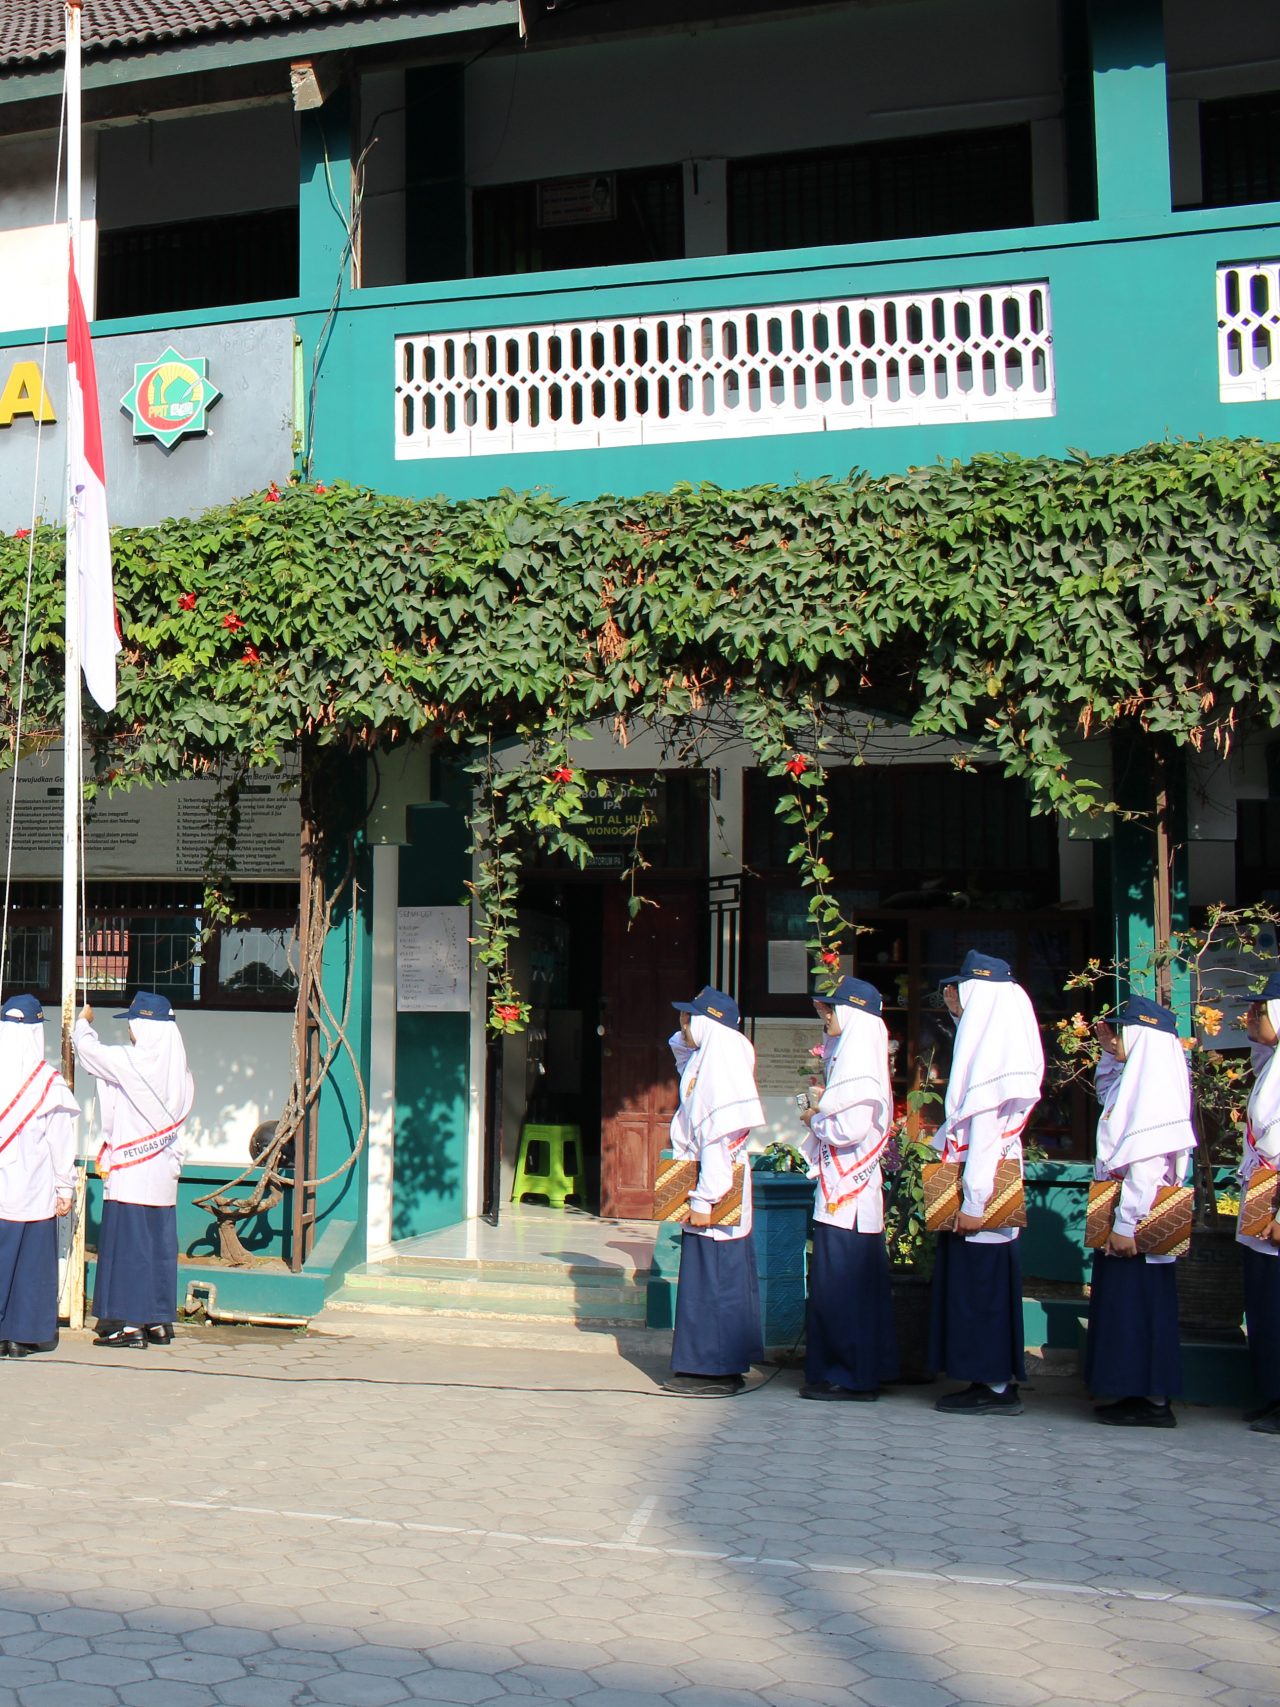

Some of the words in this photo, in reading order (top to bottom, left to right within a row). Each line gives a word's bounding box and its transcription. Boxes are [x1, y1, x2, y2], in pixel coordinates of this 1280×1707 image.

[603, 801, 622, 811] IPA
[594, 815, 604, 825] IT
[608, 815, 622, 825] AL
[586, 827, 635, 836] WONOG
[123, 1140, 159, 1159] PETUGAS
